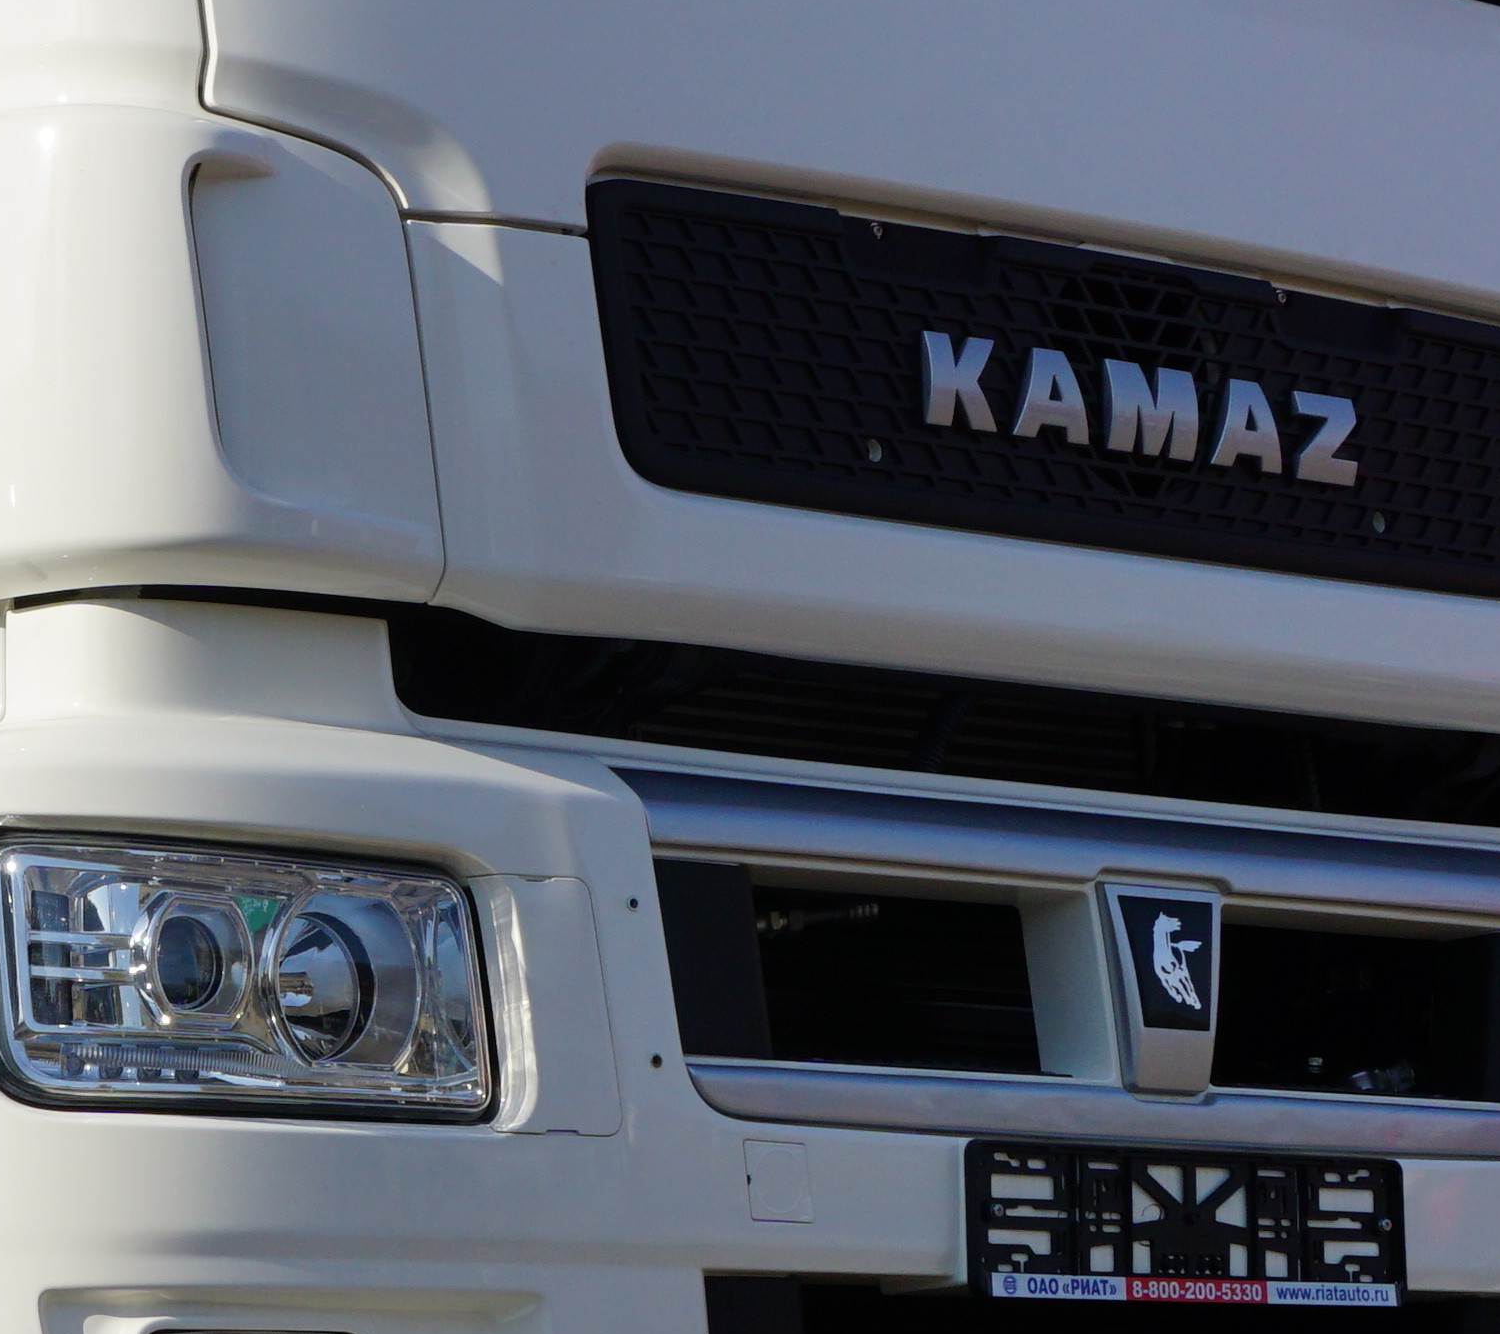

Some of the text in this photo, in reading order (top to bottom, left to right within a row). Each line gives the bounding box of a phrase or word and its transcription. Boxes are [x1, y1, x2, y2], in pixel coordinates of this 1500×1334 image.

[921, 329, 1359, 487] KAMAZ
[1027, 1276, 1118, 1297] ОАО «РИАТ»
[1132, 1280, 1262, 1301] 8-800-200-5330
[1275, 1284, 1390, 1303] www.riatauto.ru
